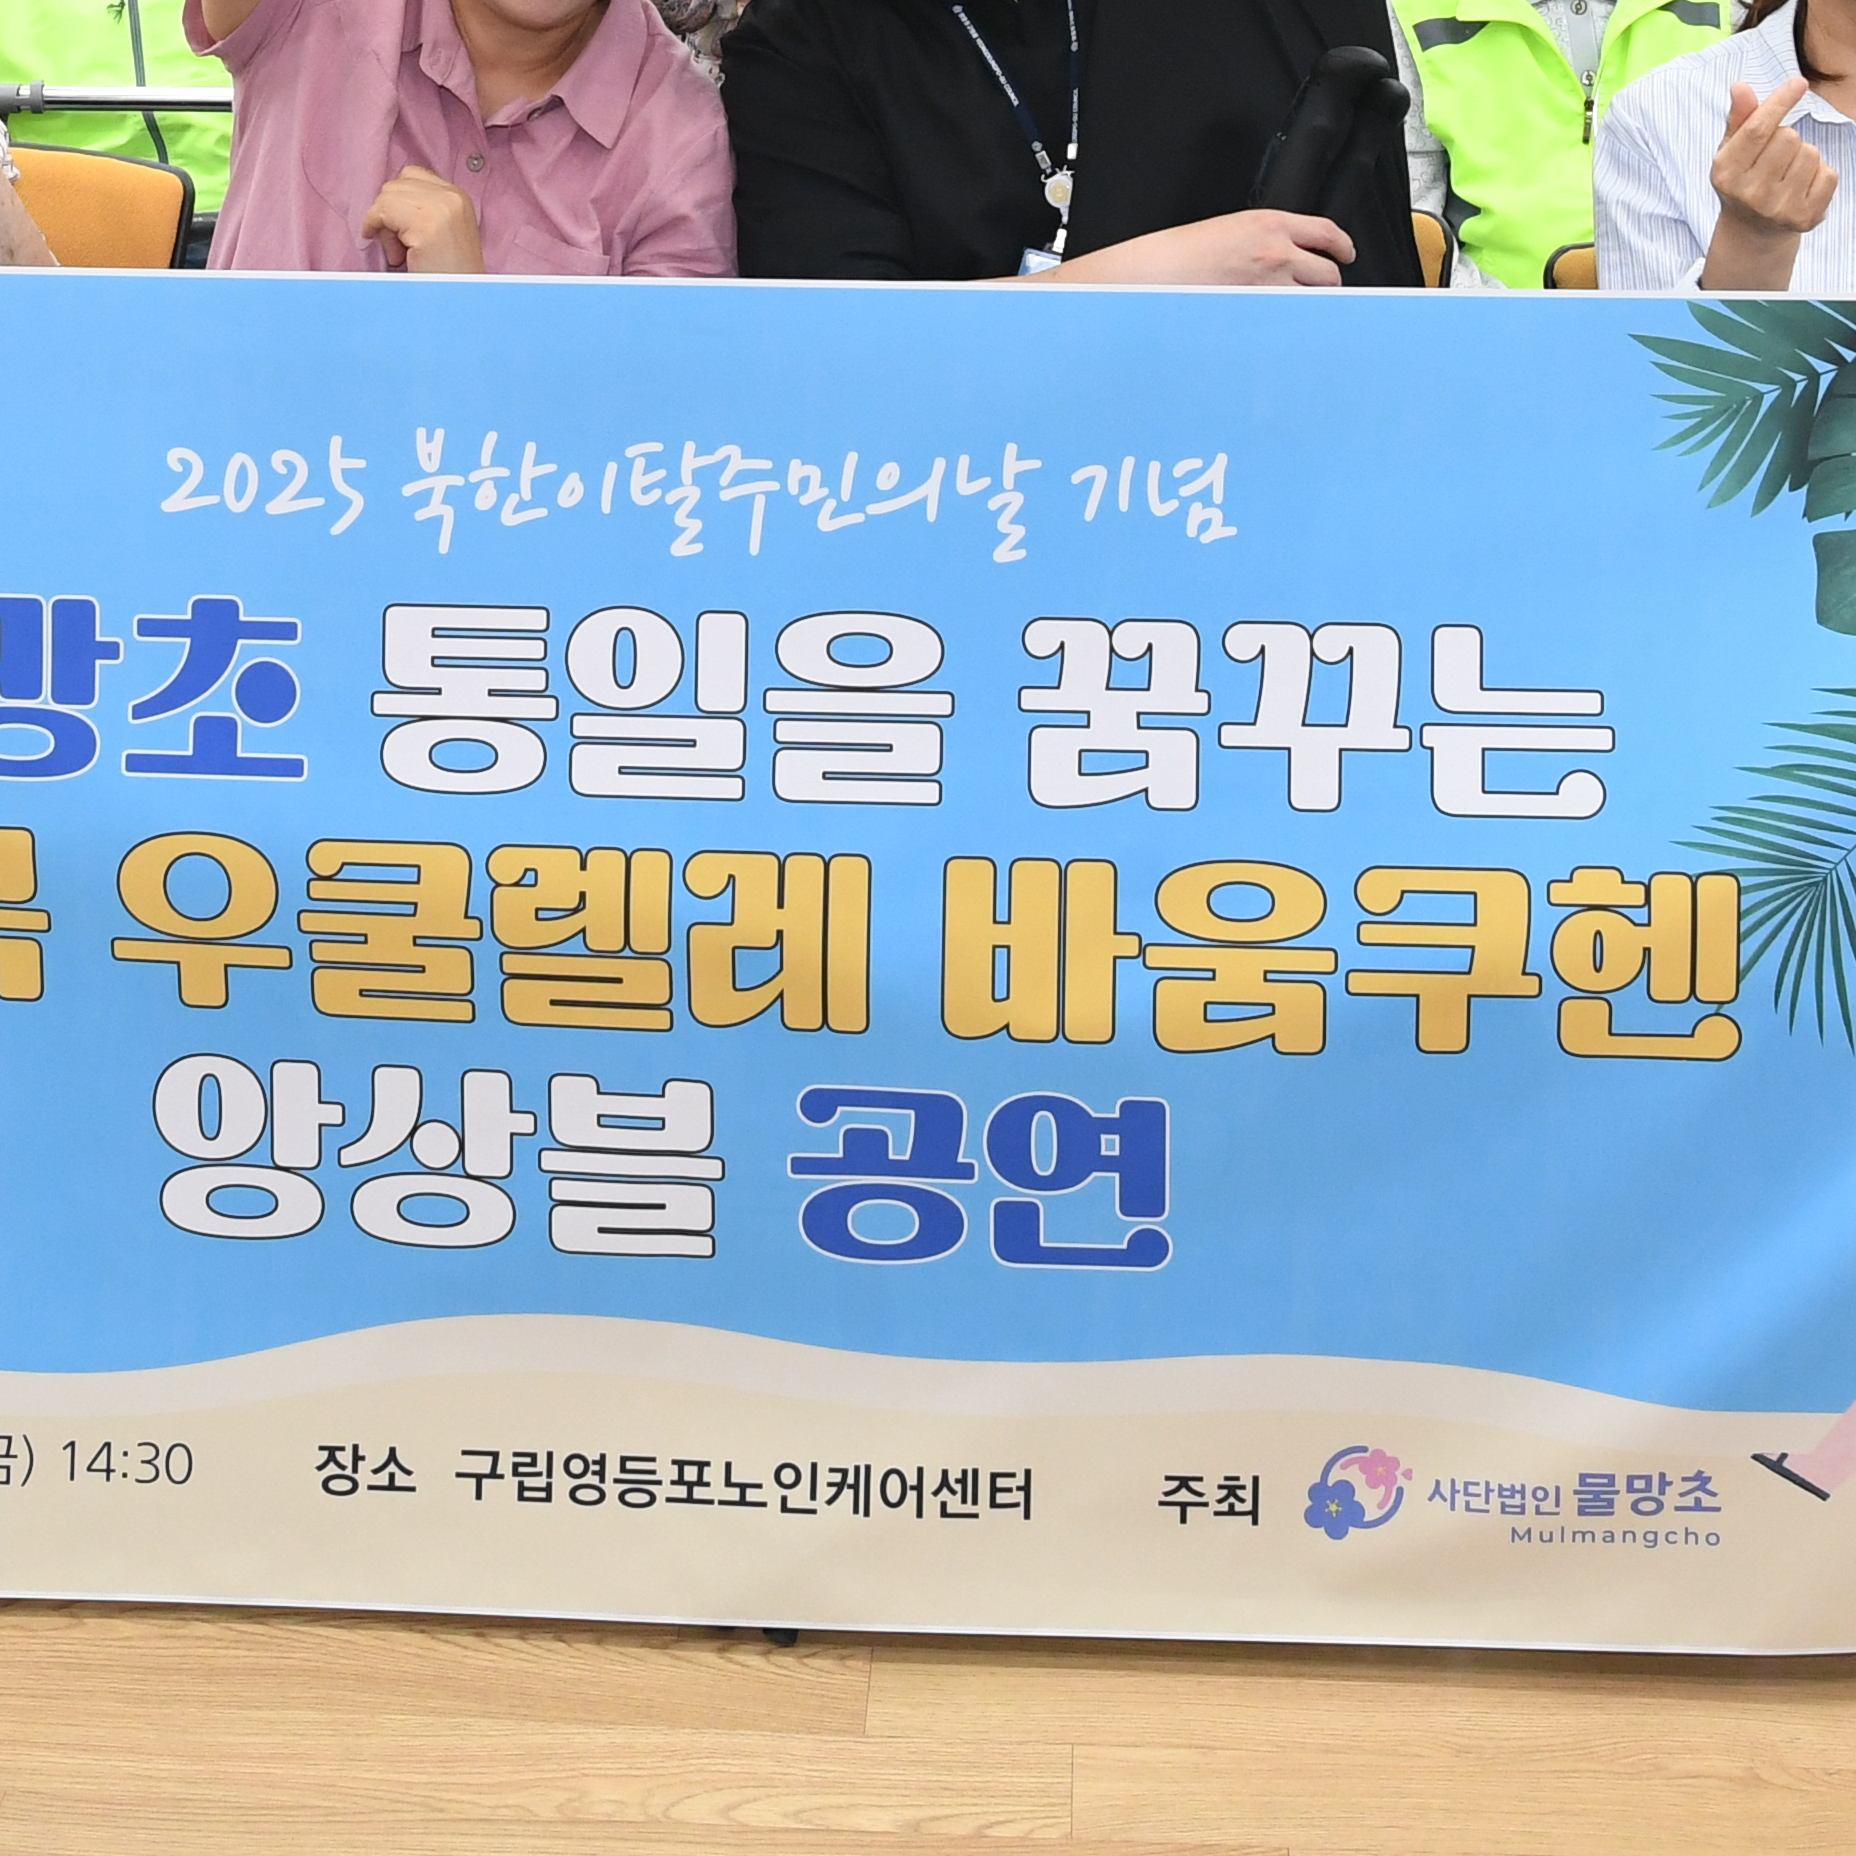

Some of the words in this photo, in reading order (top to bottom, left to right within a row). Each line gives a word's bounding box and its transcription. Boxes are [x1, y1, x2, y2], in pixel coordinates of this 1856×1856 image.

[160, 434, 368, 537] 2025
[1071, 452, 1238, 545] 기념
[370, 602, 955, 807] 통일을
[1017, 615, 1616, 820] 꿈꾸는
[109, 830, 872, 1035] 우쿨렐레
[939, 855, 1743, 1062] 바움쿠헨
[151, 1051, 726, 1259] 앙상블
[785, 1084, 1174, 1272] 공연
[61, 1439, 195, 1486] 14:30
[314, 1442, 418, 1498] 장소
[453, 1447, 1034, 1520] 구립영등포노인케어센터
[1157, 1472, 1262, 1526] 주최
[1426, 1476, 1562, 1518] 사단법인
[1572, 1469, 1723, 1519] 물망초
[1510, 1525, 1722, 1549] Mulmangcho
